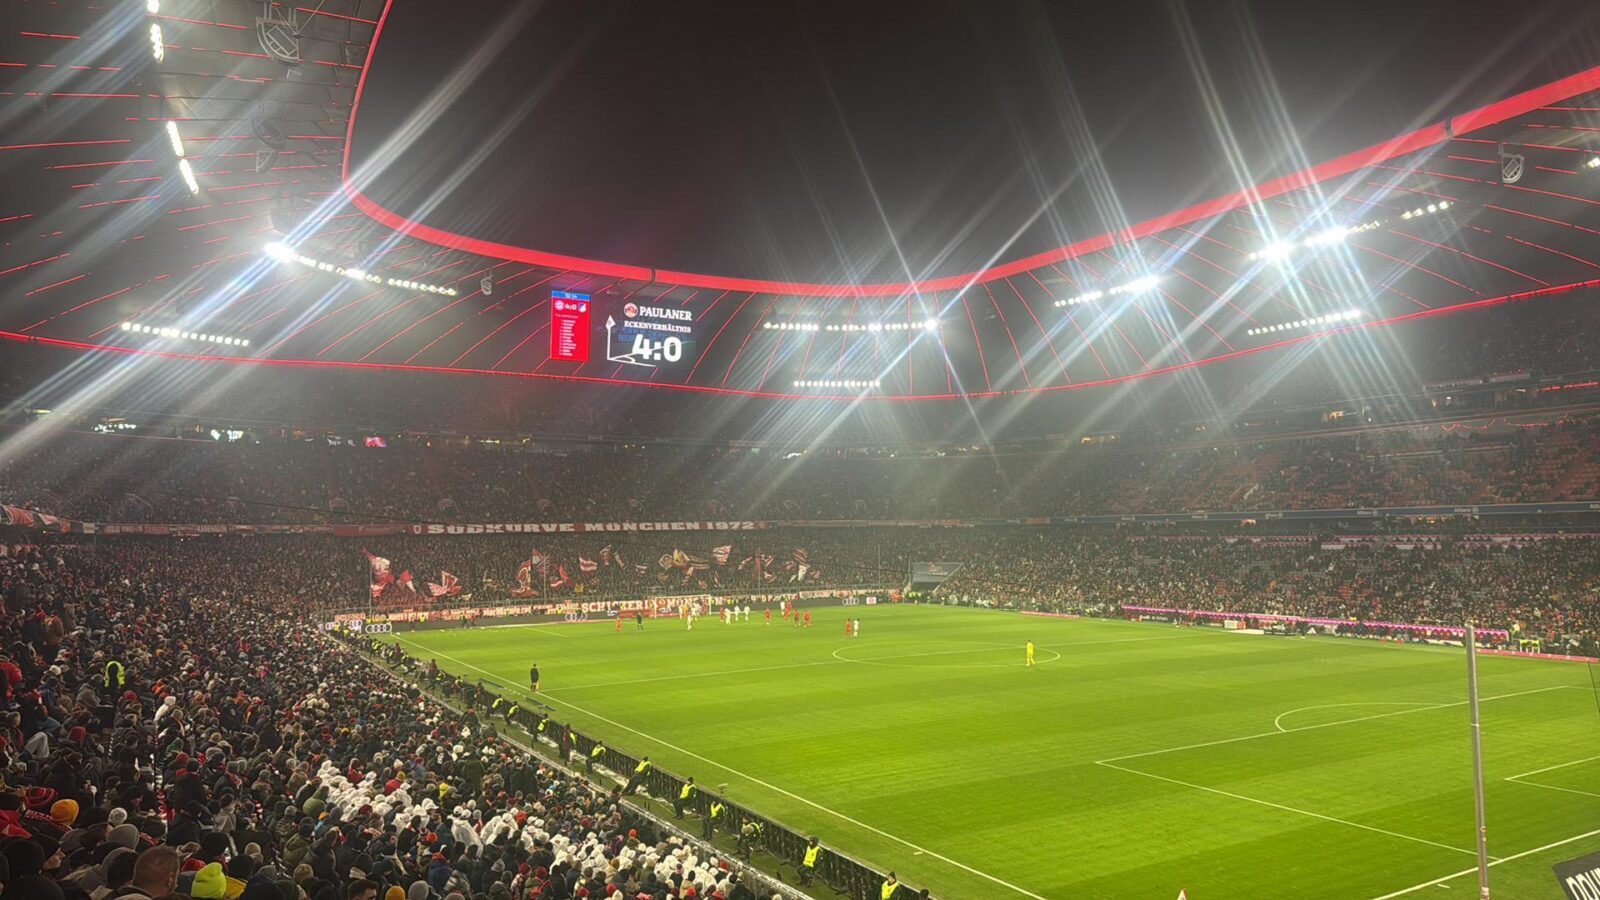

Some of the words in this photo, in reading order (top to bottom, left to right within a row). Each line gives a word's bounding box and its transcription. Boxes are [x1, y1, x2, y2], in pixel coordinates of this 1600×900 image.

[639, 306, 692, 320] PAULANER
[624, 320, 692, 333] ECKENVERHÄLTNIS
[632, 334, 682, 362] 4:0
[428, 523, 575, 534] SÜDKURVE
[584, 522, 700, 532] MÜNCHEN
[705, 521, 754, 530] 1972
